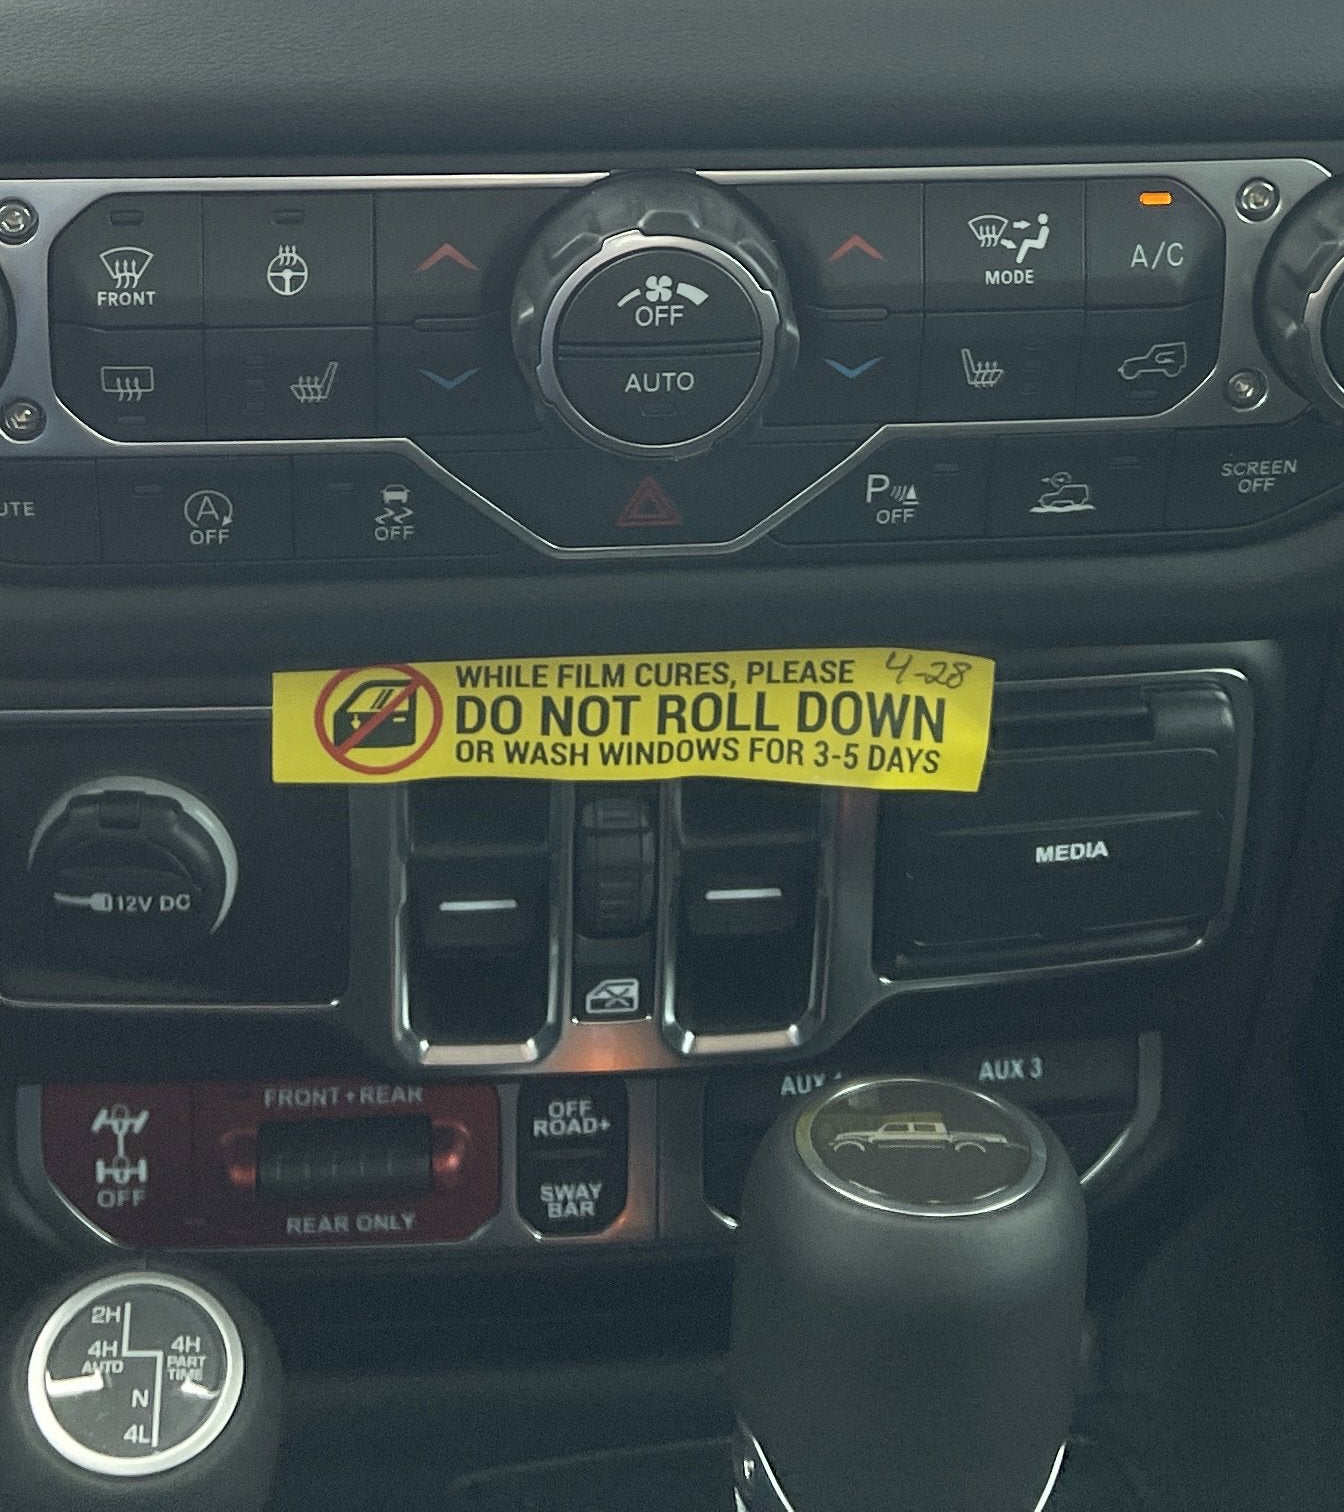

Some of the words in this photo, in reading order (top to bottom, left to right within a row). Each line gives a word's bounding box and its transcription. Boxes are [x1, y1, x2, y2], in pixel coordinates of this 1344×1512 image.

[1131, 242, 1184, 270] A/C
[985, 269, 1034, 285] MODE
[97, 290, 156, 307] FRONT
[635, 305, 684, 327] OFF
[624, 372, 695, 393] AUTO
[1221, 459, 1298, 477] SCREEN
[1237, 478, 1275, 494] OFF
[876, 509, 915, 525] OFF
[189, 529, 230, 545] OFF
[374, 525, 415, 541] OFF
[456, 665, 549, 688] WHILE
[557, 664, 626, 688] FILM
[634, 662, 736, 690] CURES,
[746, 659, 855, 685] PLEASE
[885, 651, 972, 689] 4-28
[456, 695, 522, 735] DO
[541, 694, 641, 738] NOT
[658, 691, 780, 735] ROLL
[798, 691, 946, 743] DOWN
[456, 739, 496, 763] OR
[503, 740, 589, 766] WASH
[600, 738, 739, 767] WINDOWS
[750, 739, 804, 766] FOR
[813, 743, 859, 769] 3-5
[868, 746, 941, 775] DAYS
[1035, 841, 1109, 864] MEDIA
[117, 894, 153, 913] 12V
[159, 893, 191, 912] DC
[978, 1058, 1024, 1081] AUX
[1028, 1057, 1044, 1079] 3
[548, 1100, 592, 1118] OFF
[533, 1117, 611, 1136] ROAD+
[98, 1189, 145, 1208] OFF
[540, 1183, 603, 1202] SWAY
[547, 1201, 595, 1218] BAR
[286, 1214, 349, 1234] REAR
[356, 1211, 416, 1232] ONLY
[91, 1306, 121, 1324] 2H
[87, 1340, 118, 1358] 4H
[171, 1335, 201, 1353] 4H
[81, 1360, 124, 1374] AUTO
[167, 1356, 207, 1368] PART
[168, 1368, 203, 1381] TIME
[131, 1389, 149, 1408] N
[123, 1424, 151, 1444] 4L
